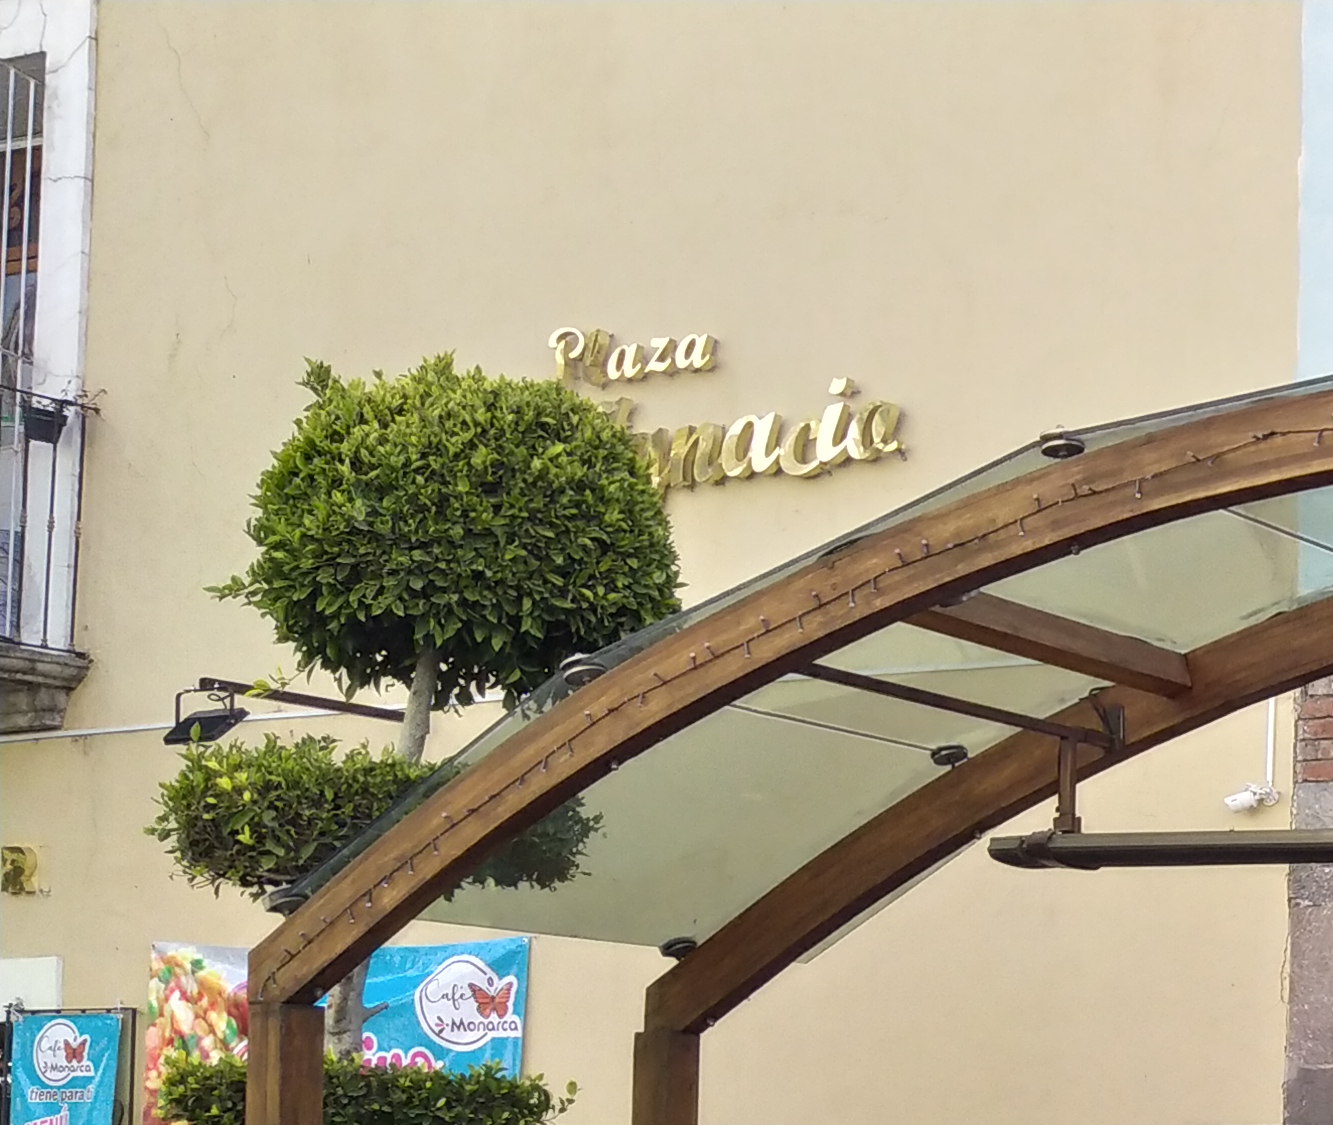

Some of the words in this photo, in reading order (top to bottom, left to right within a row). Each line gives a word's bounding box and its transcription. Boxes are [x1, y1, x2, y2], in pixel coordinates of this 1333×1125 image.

[548, 326, 716, 388] Plaza
[424, 978, 473, 1010] Café
[451, 1017, 519, 1033] Monarca
[50, 1060, 92, 1073] Monarca
[29, 1088, 58, 1101] tiene
[60, 1090, 84, 1104] para
[85, 1088, 93, 1100] ti
